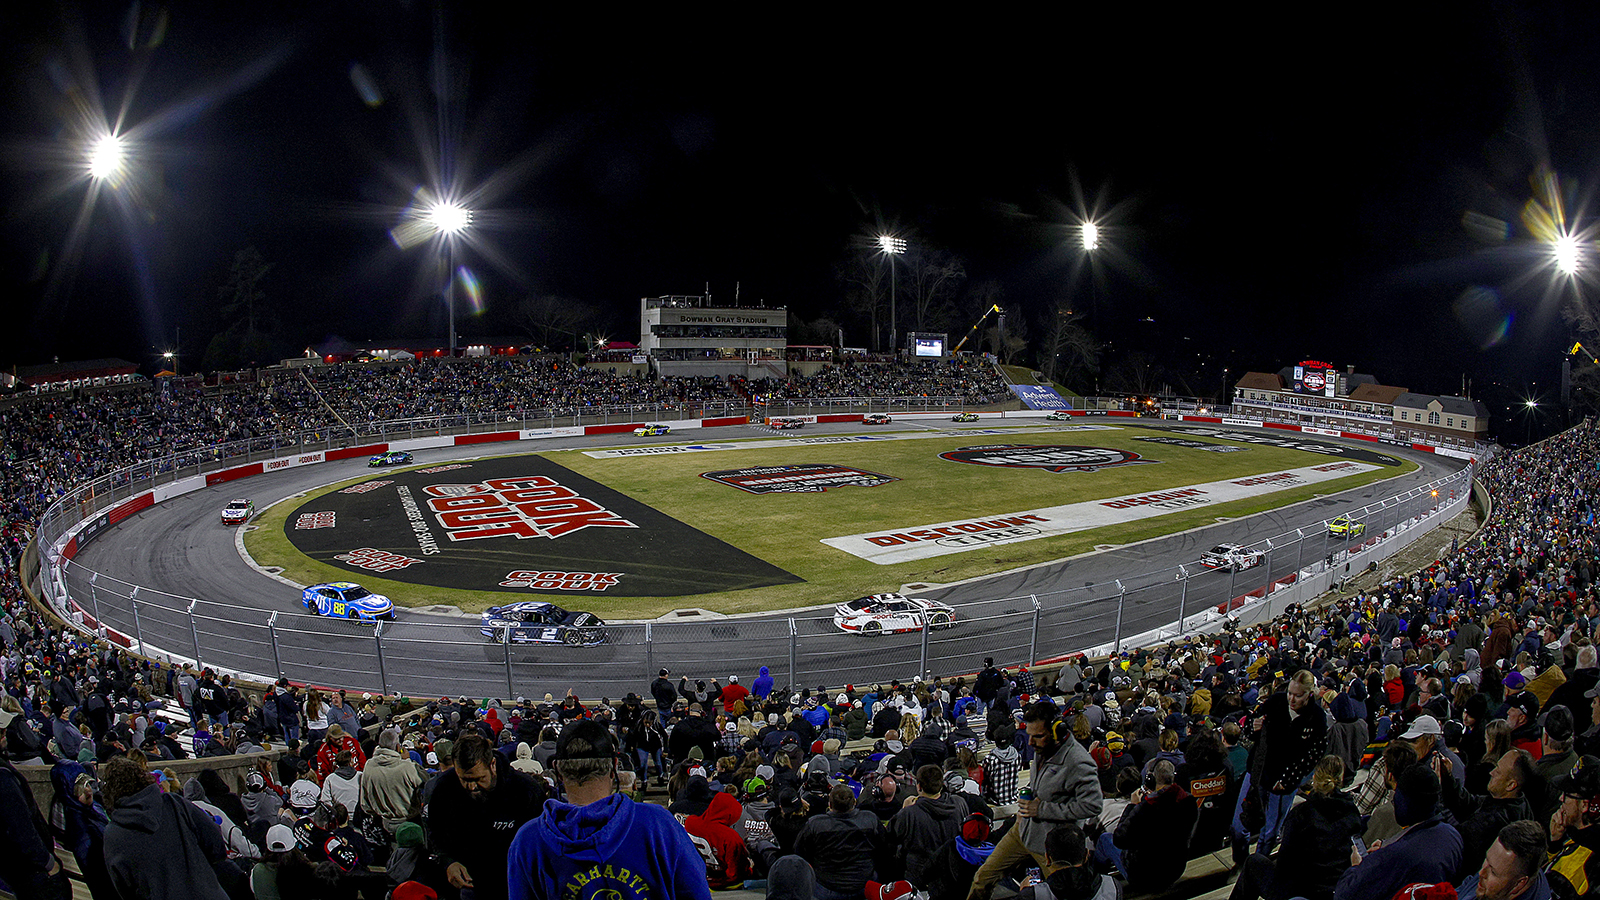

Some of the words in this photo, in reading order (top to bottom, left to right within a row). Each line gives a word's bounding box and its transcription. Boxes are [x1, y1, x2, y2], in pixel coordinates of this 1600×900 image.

[1032, 399, 1066, 407] Health
[302, 455, 313, 463] COOK
[1230, 473, 1300, 486] DISCOUNT
[1099, 488, 1209, 509] DISCOUNT
[1155, 498, 1204, 508] TIRE
[482, 475, 640, 540] COOK
[426, 494, 540, 542] OUT
[864, 514, 1050, 547] DISCOUNT
[946, 528, 1031, 544] TIRE
[349, 548, 425, 568] COOK
[346, 557, 406, 573] OUT
[505, 570, 625, 584] COOK
[530, 580, 619, 591] OUT
[334, 602, 345, 615] 88
[541, 628, 558, 639] 2
[200, 687, 214, 700] CAT
[493, 820, 515, 830] 1776
